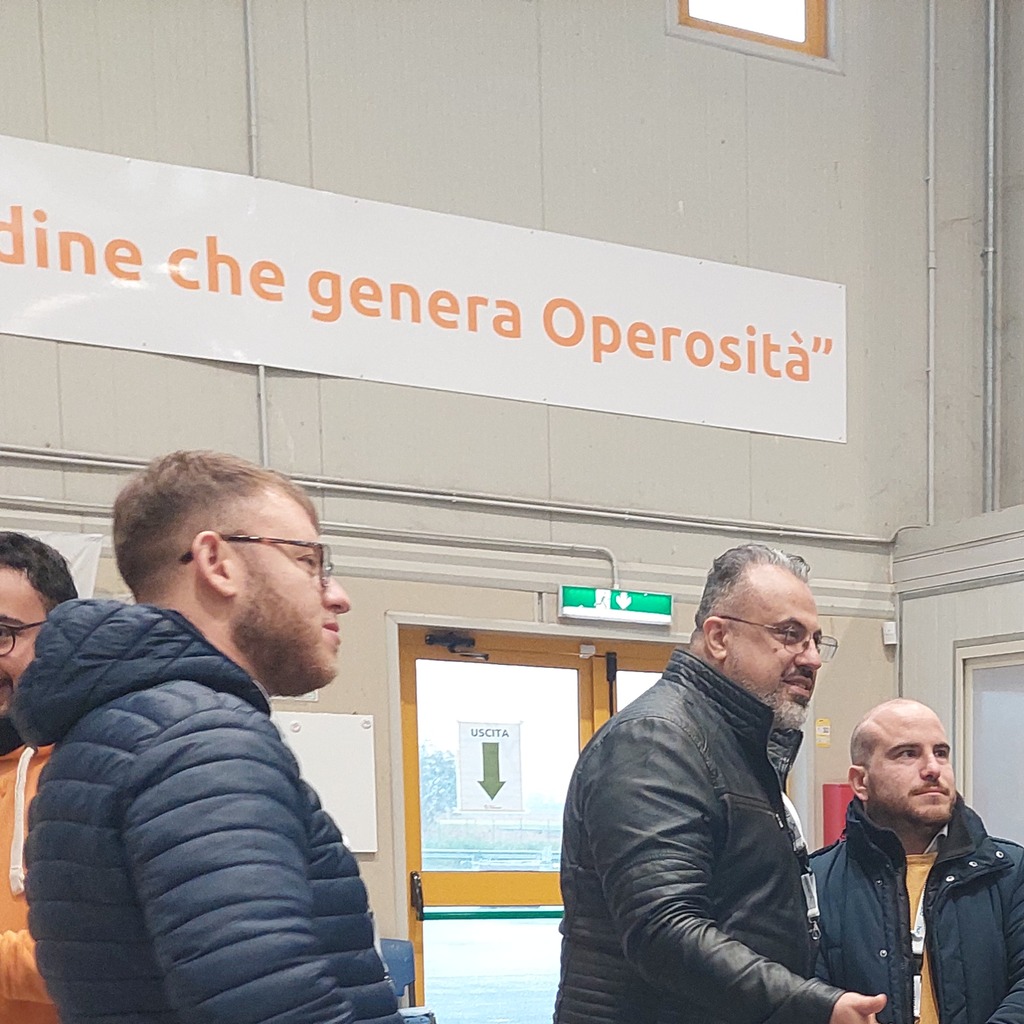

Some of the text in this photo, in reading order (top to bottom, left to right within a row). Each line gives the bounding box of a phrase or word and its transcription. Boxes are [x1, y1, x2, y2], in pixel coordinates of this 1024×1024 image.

[168, 235, 286, 302] che
[308, 270, 522, 339] genera
[471, 728, 510, 738] USCITA
